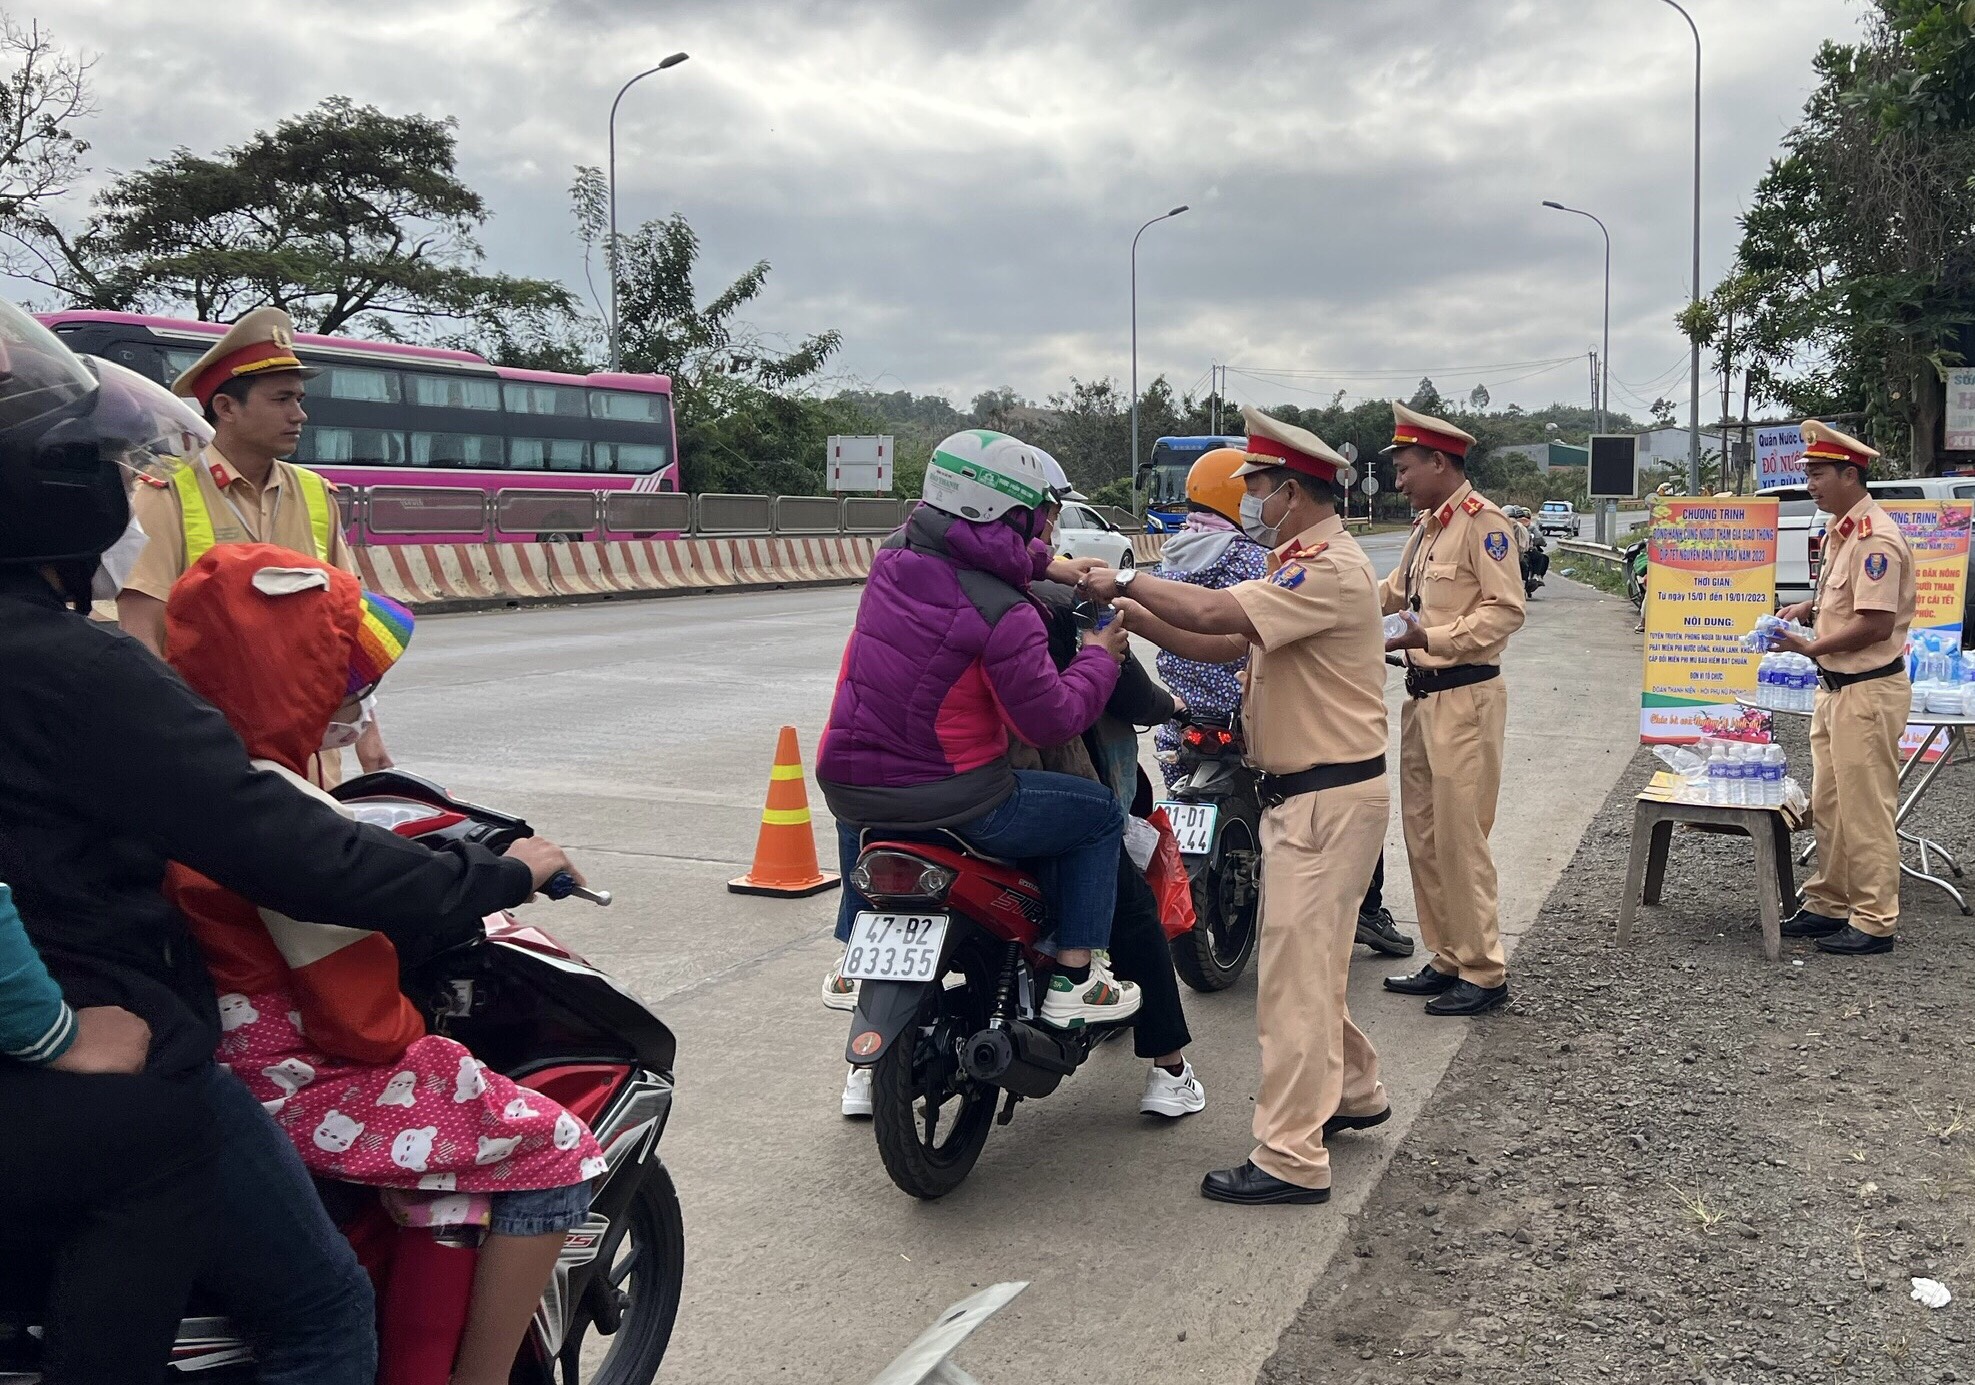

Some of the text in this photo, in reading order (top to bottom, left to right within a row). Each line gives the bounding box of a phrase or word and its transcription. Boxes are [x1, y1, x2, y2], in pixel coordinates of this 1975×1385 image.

[1759, 432, 1777, 447] Quán
[1762, 449, 1777, 474] ĐỔ
[1752, 549, 1765, 561] 2023
[1934, 582, 1955, 591] THAM
[1688, 592, 1707, 601] 15/01
[1704, 617, 1734, 627] DUNG:
[865, 916, 932, 945] 47-B2
[847, 946, 935, 976] 833.55
